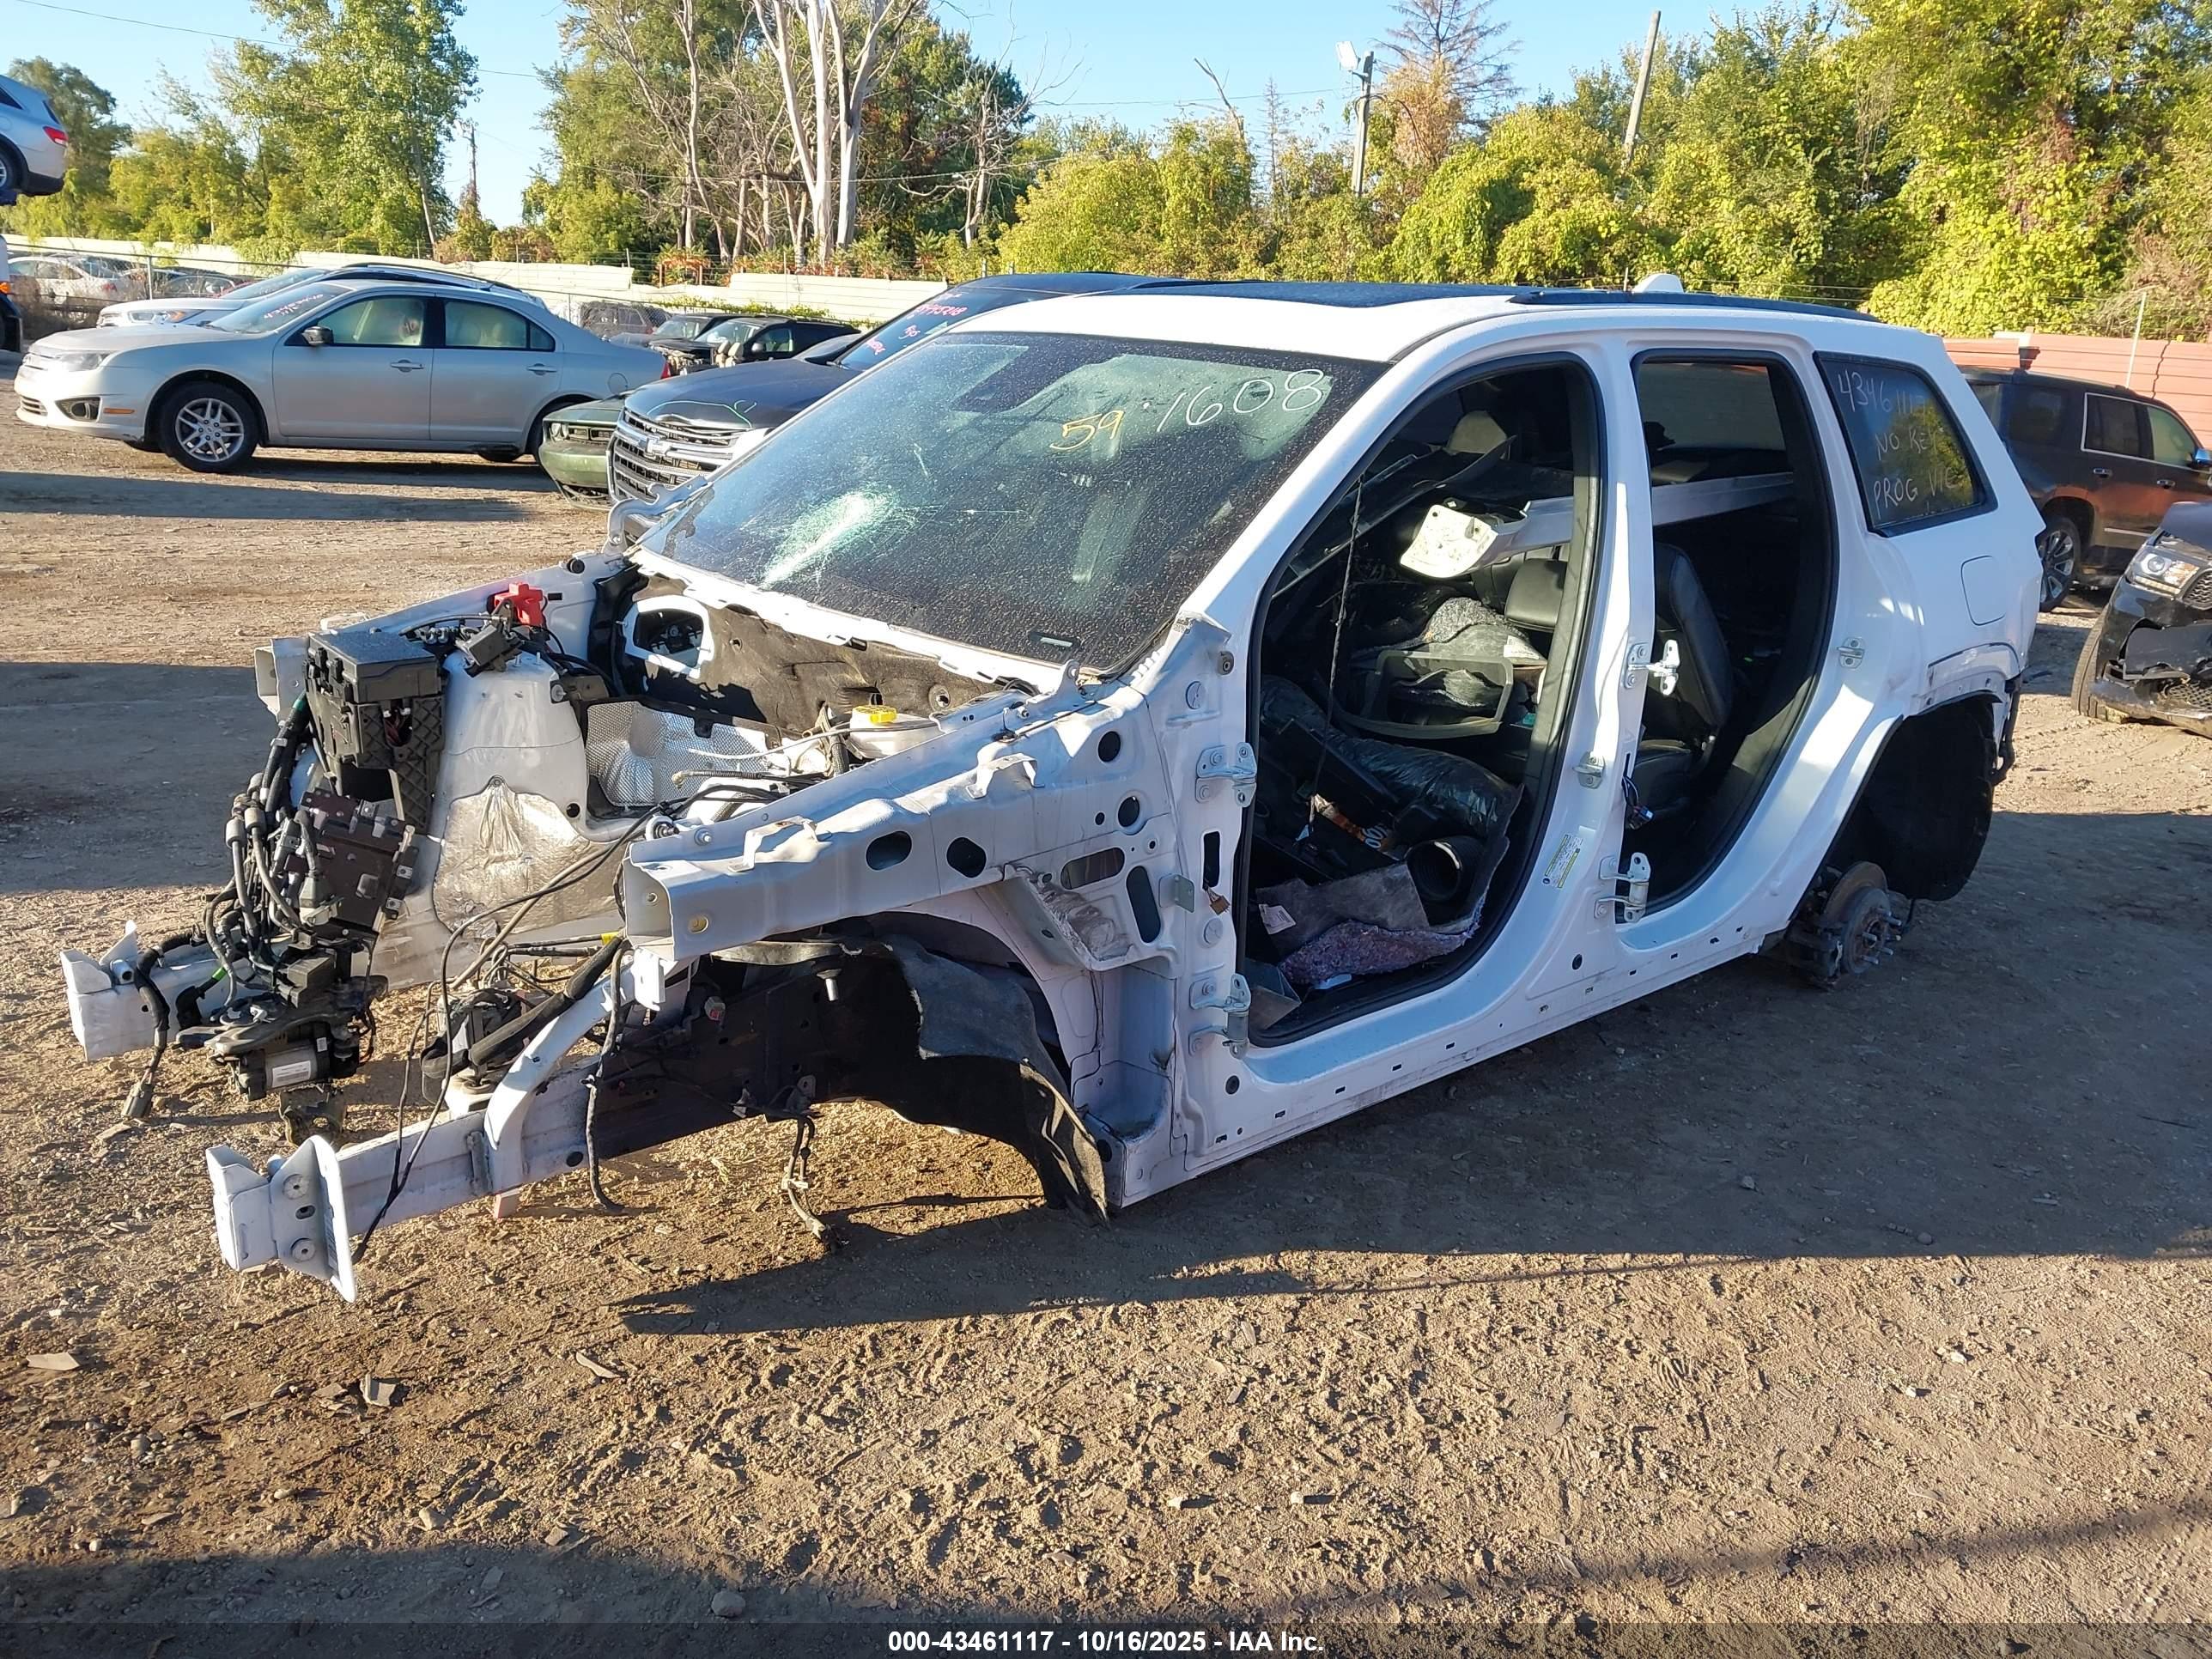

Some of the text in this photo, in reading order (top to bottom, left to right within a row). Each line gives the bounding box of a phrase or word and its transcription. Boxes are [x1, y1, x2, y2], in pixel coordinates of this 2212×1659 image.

[1156, 368, 1325, 433] 1608
[1838, 370, 1926, 424] 43461117
[1048, 409, 1125, 451] 59
[1875, 427, 1938, 461] NO KEY
[1874, 477, 1918, 520] PROG
